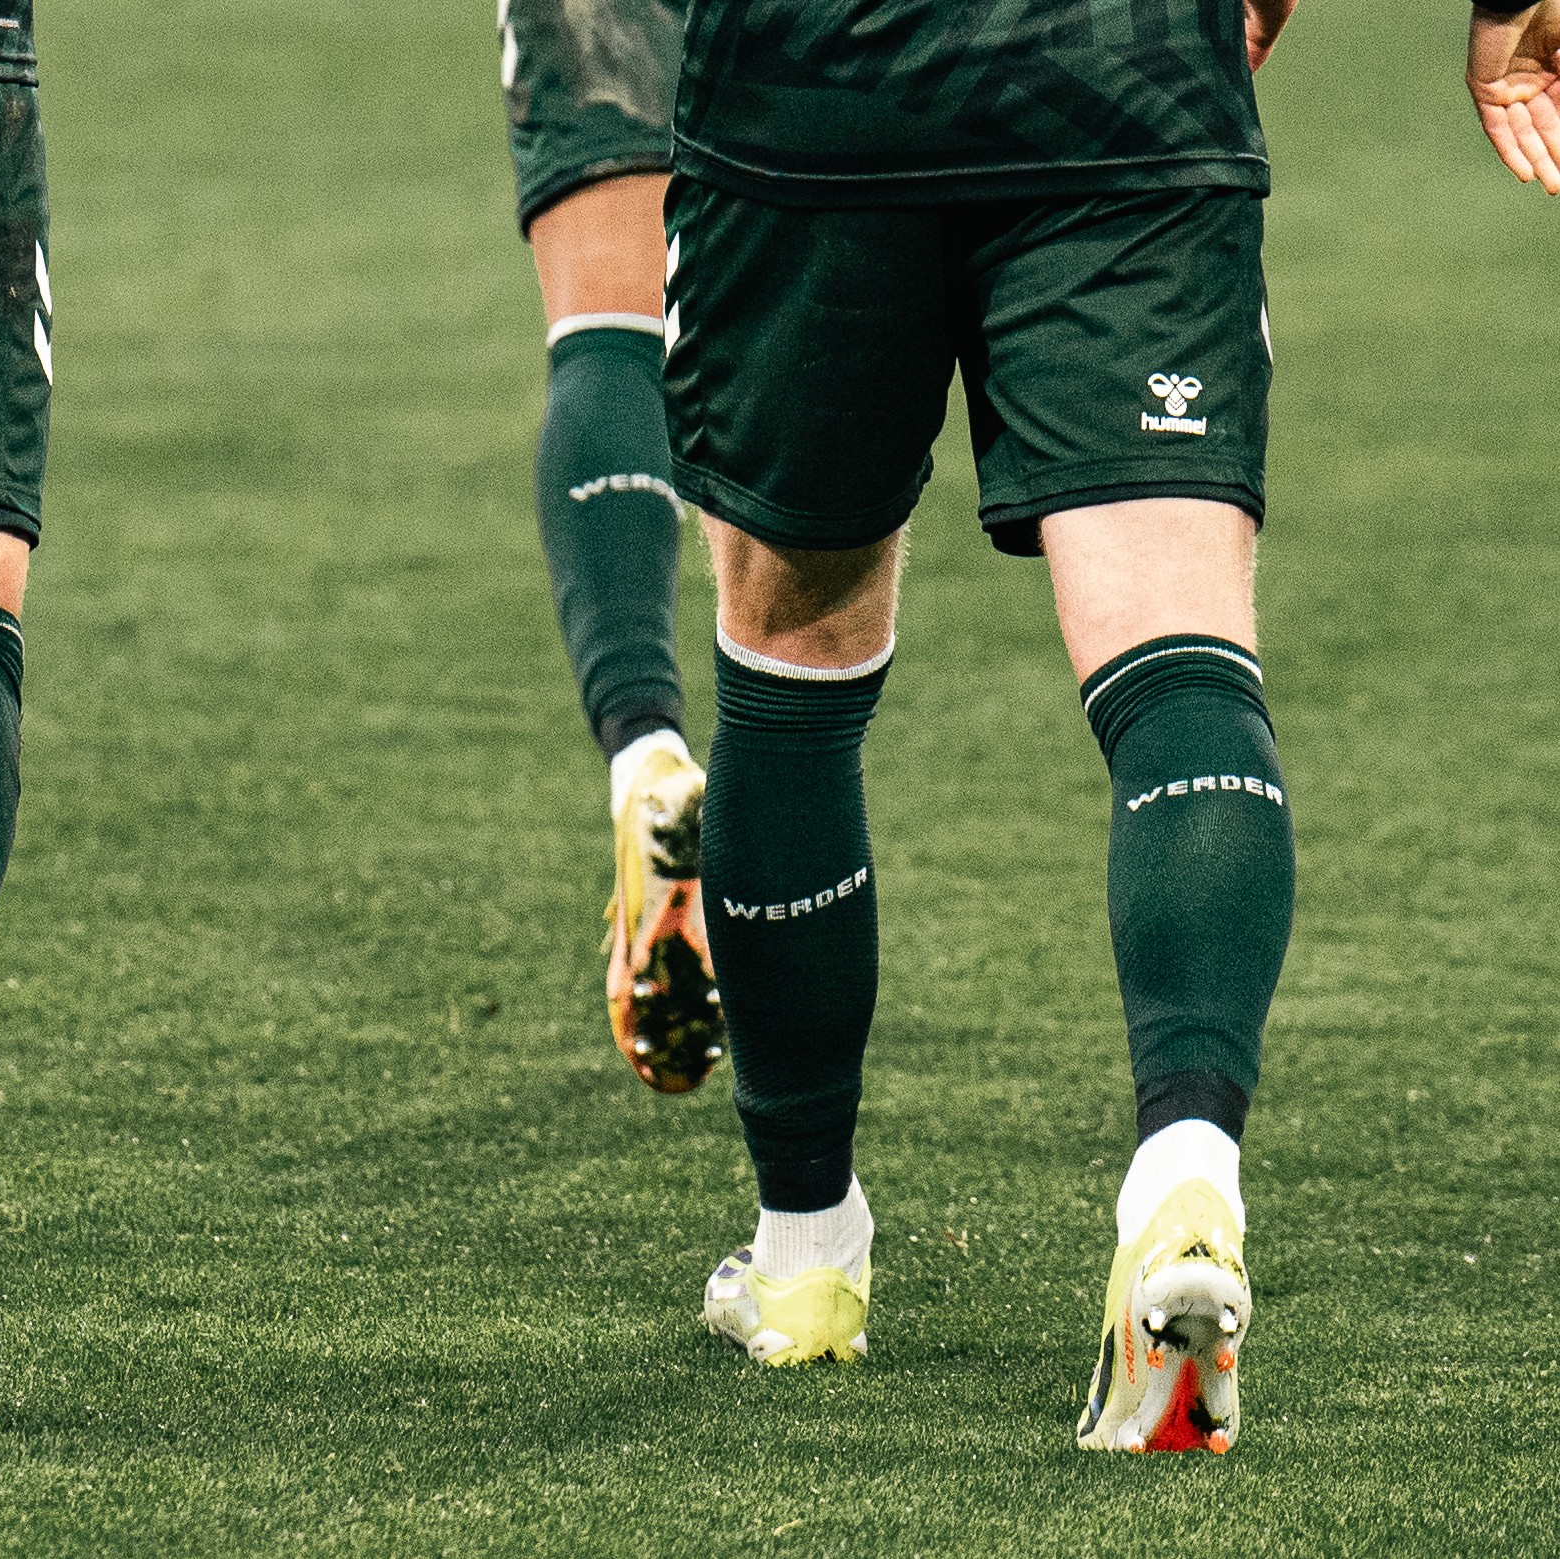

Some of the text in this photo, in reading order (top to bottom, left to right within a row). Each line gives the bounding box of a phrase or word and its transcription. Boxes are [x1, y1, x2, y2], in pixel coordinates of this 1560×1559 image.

[1141, 412, 1207, 436] hummel
[1126, 774, 1283, 812] WERDER
[723, 866, 867, 920] WERDER
